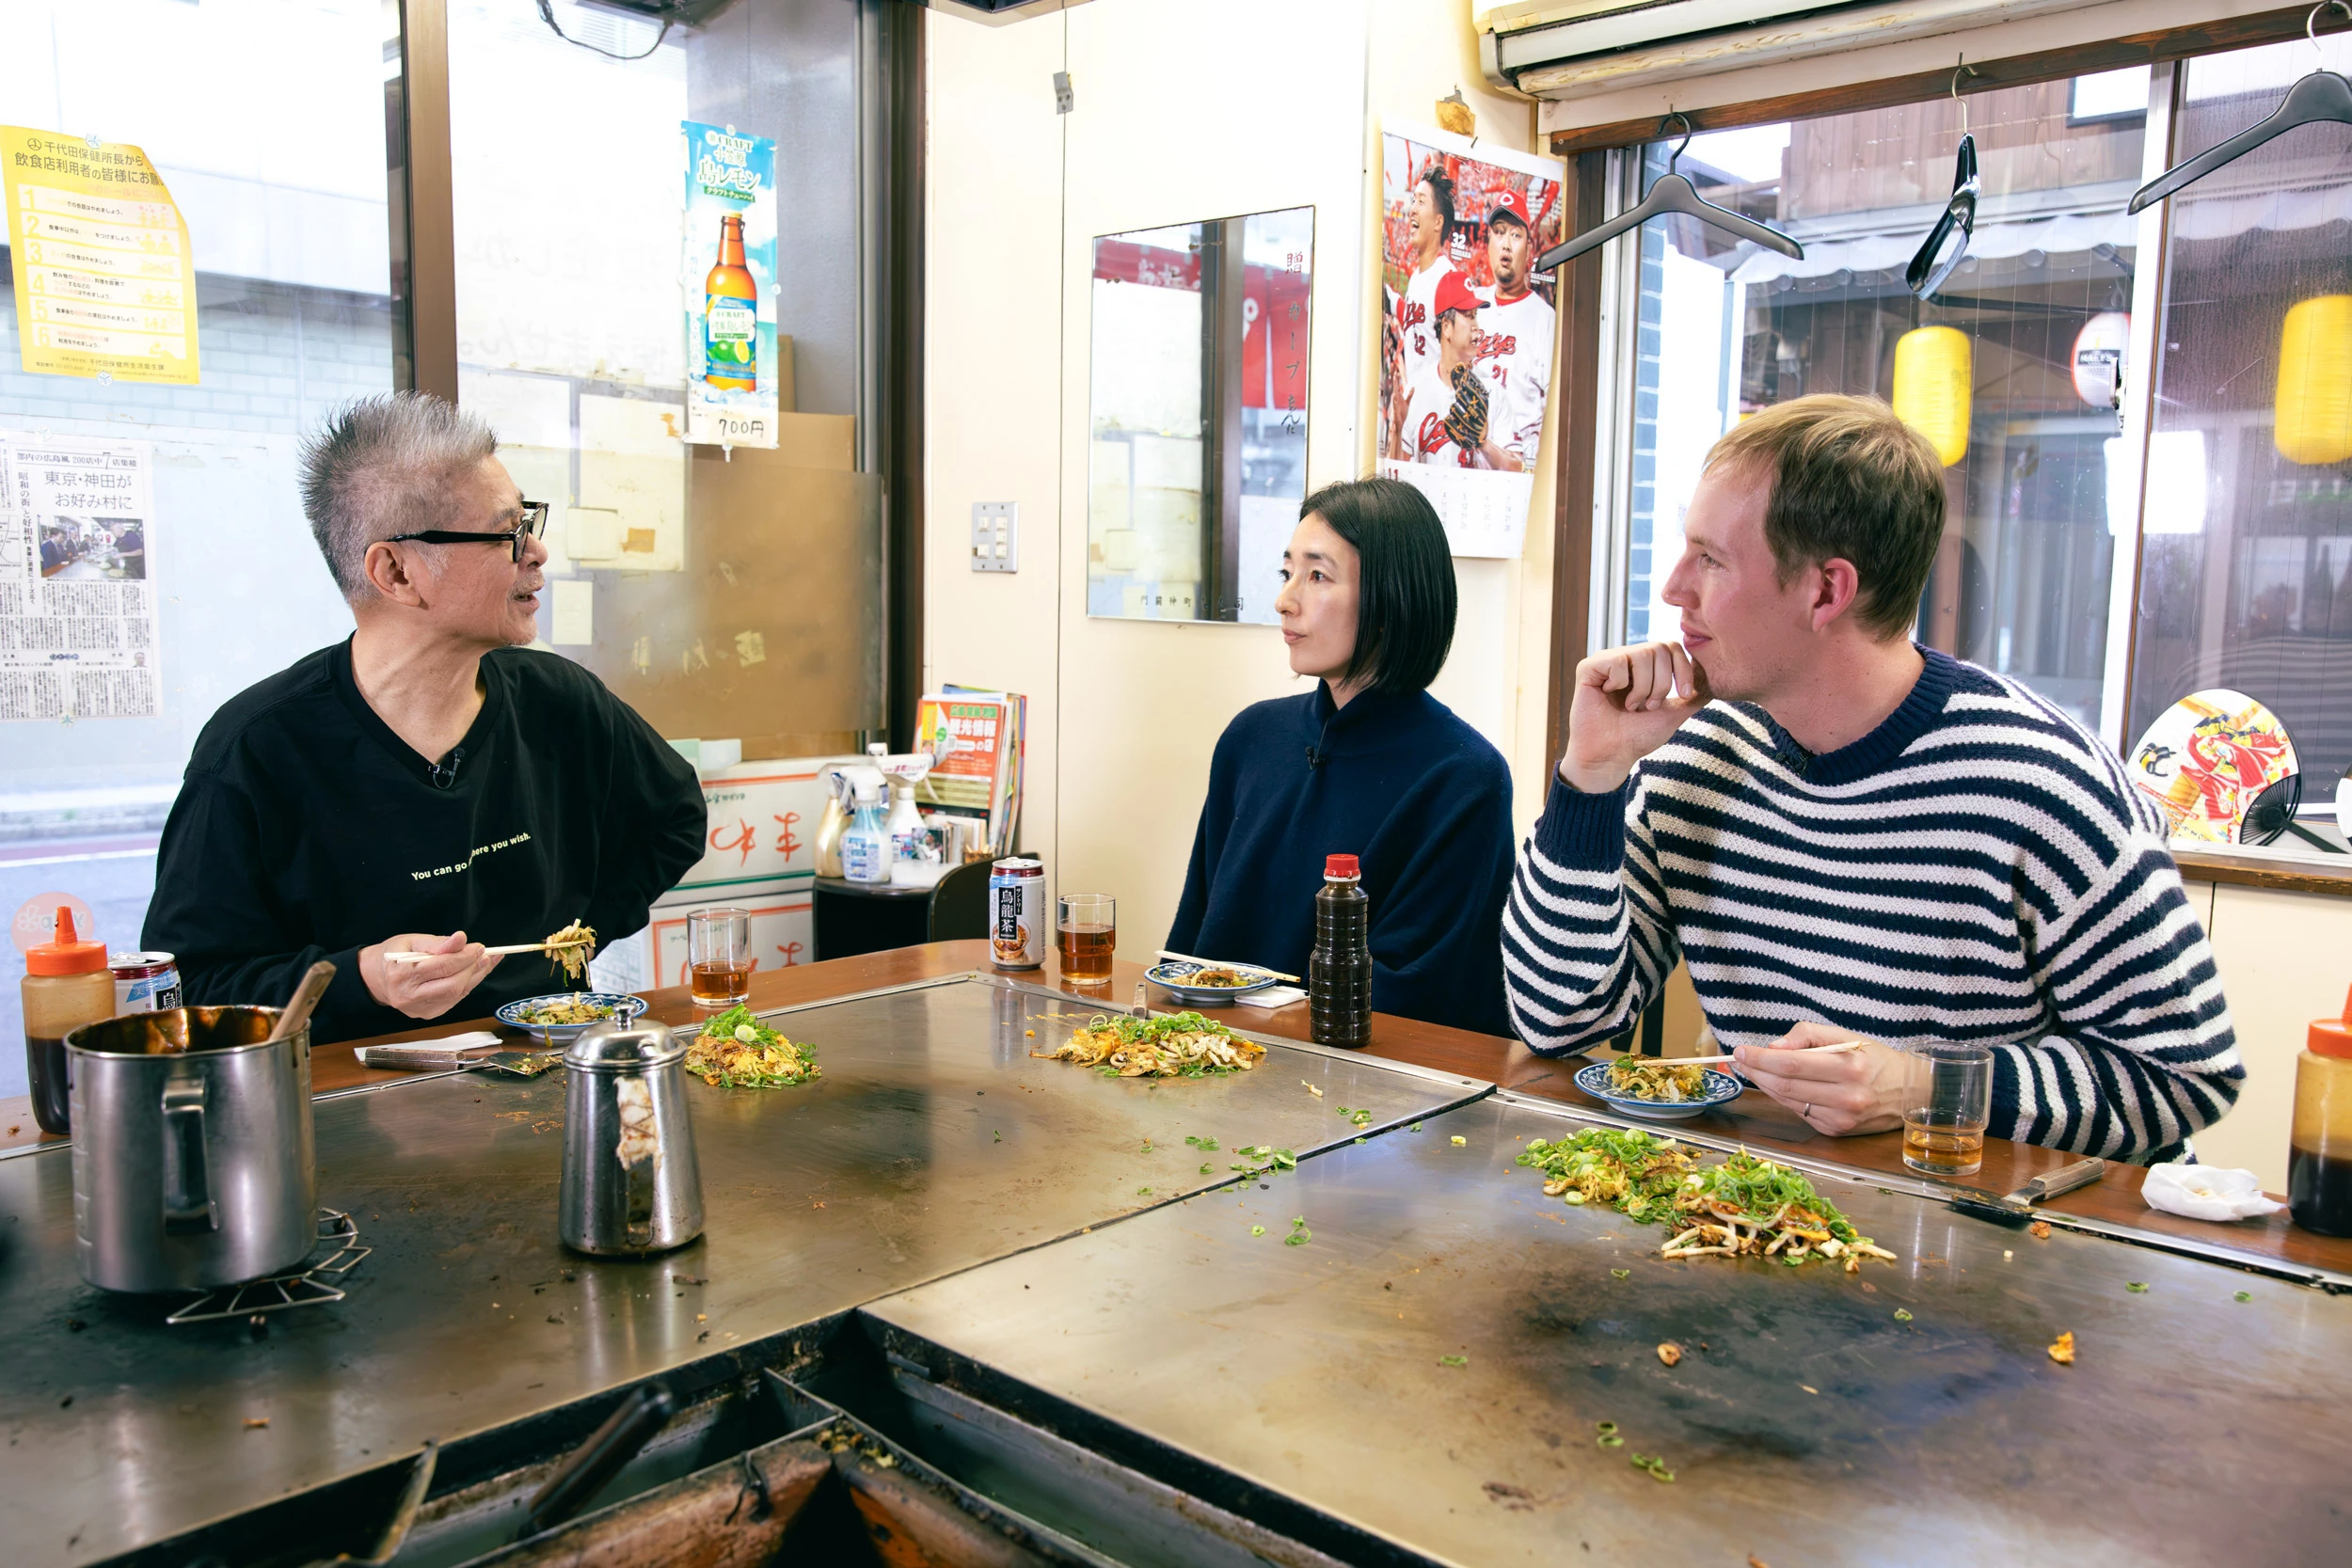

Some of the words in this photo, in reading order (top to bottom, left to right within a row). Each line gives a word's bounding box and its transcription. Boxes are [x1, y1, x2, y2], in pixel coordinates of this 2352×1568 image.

[43, 139, 144, 167] 千代田保健所長から
[718, 135, 753, 152] CRAFT
[14, 151, 166, 188] 飲食店利用者の皆様にお願
[697, 158, 762, 192] 島レモン
[1451, 231, 1466, 250] 32
[719, 417, 765, 438] 700円
[43, 470, 133, 489] 東京・神田が
[55, 492, 134, 511] お好み村に
[411, 870, 432, 882] You
[434, 865, 453, 877] can
[454, 862, 468, 873] go
[491, 840, 508, 852] you
[509, 832, 532, 846] wish.
[1001, 890, 1015, 933] 烏龍茶
